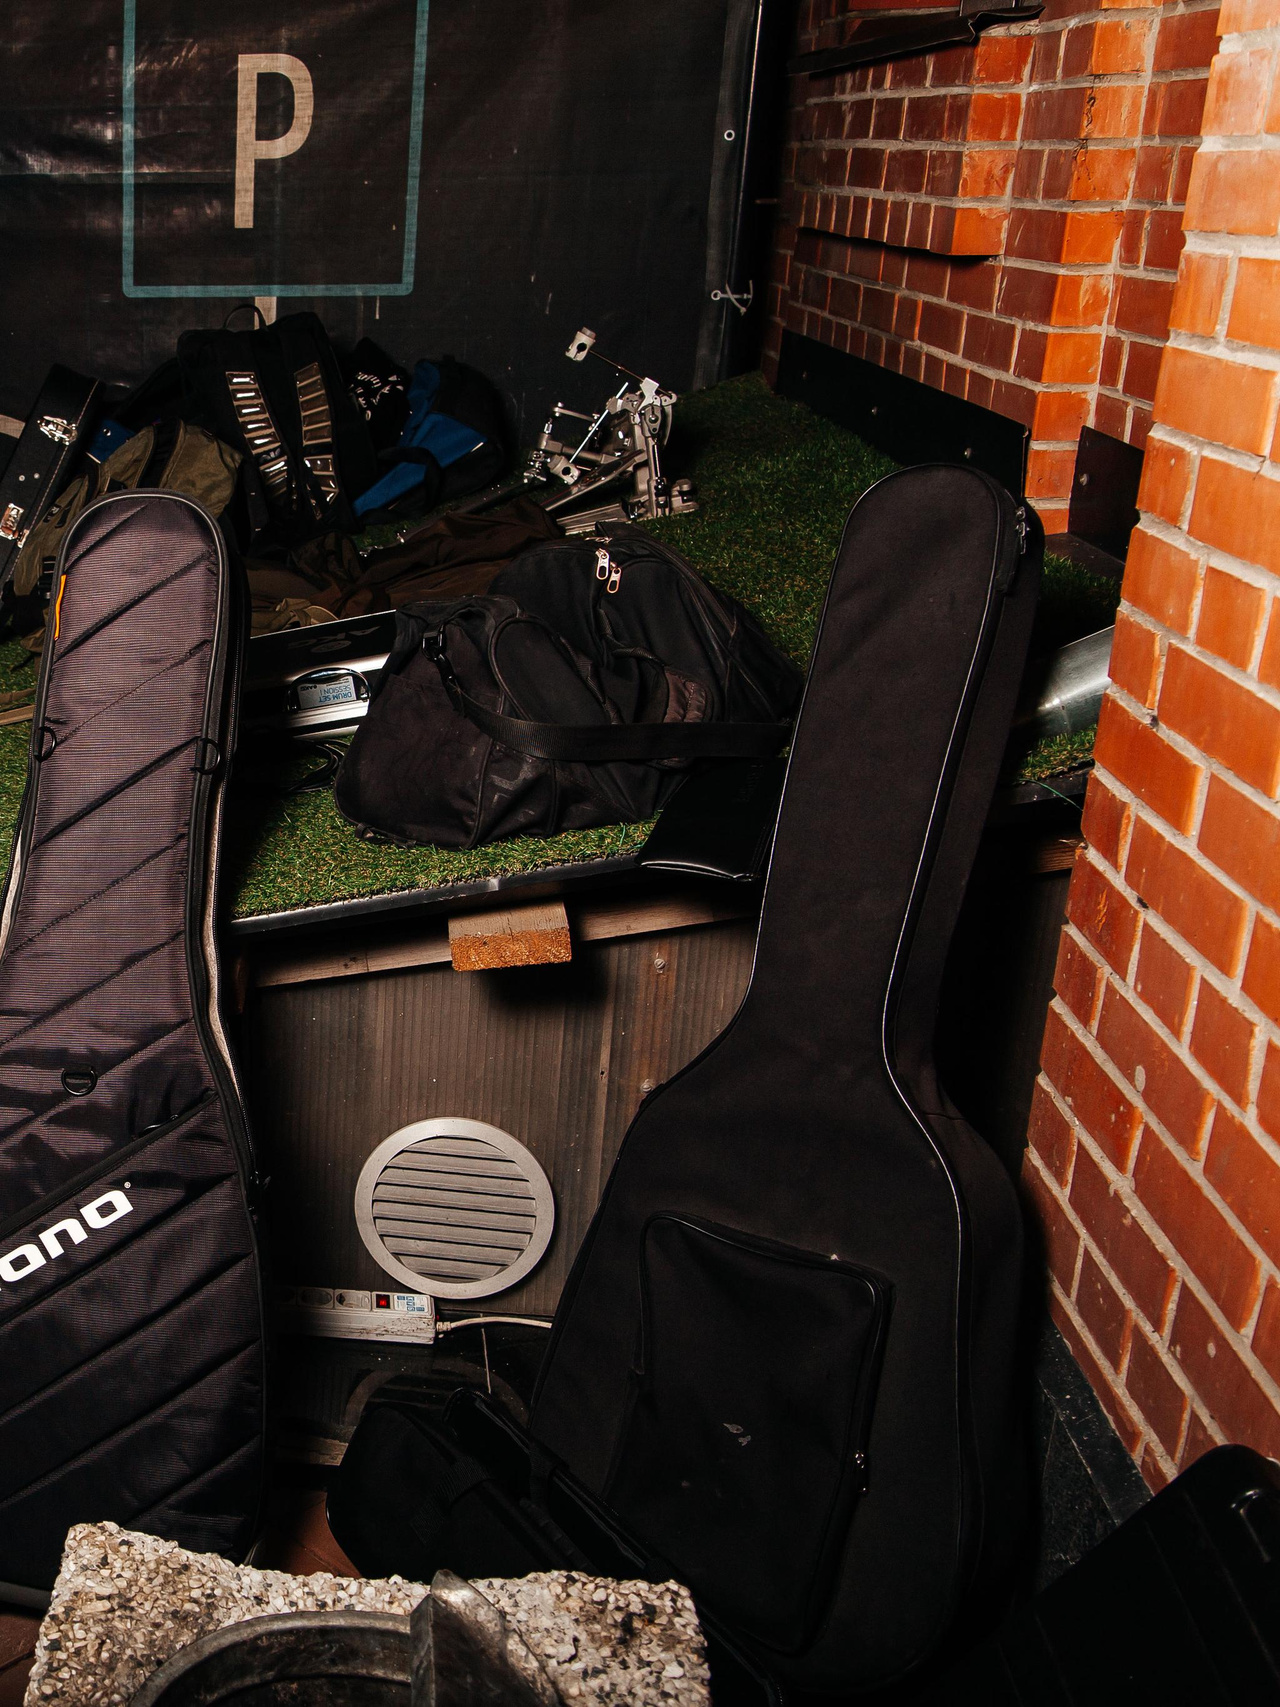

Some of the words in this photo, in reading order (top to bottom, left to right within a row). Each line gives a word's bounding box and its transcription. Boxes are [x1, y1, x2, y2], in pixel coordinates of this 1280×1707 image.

[234, 53, 314, 228] P
[324, 684, 351, 694] SESSION
[319, 695, 332, 703] SET
[332, 691, 352, 701] DRUM
